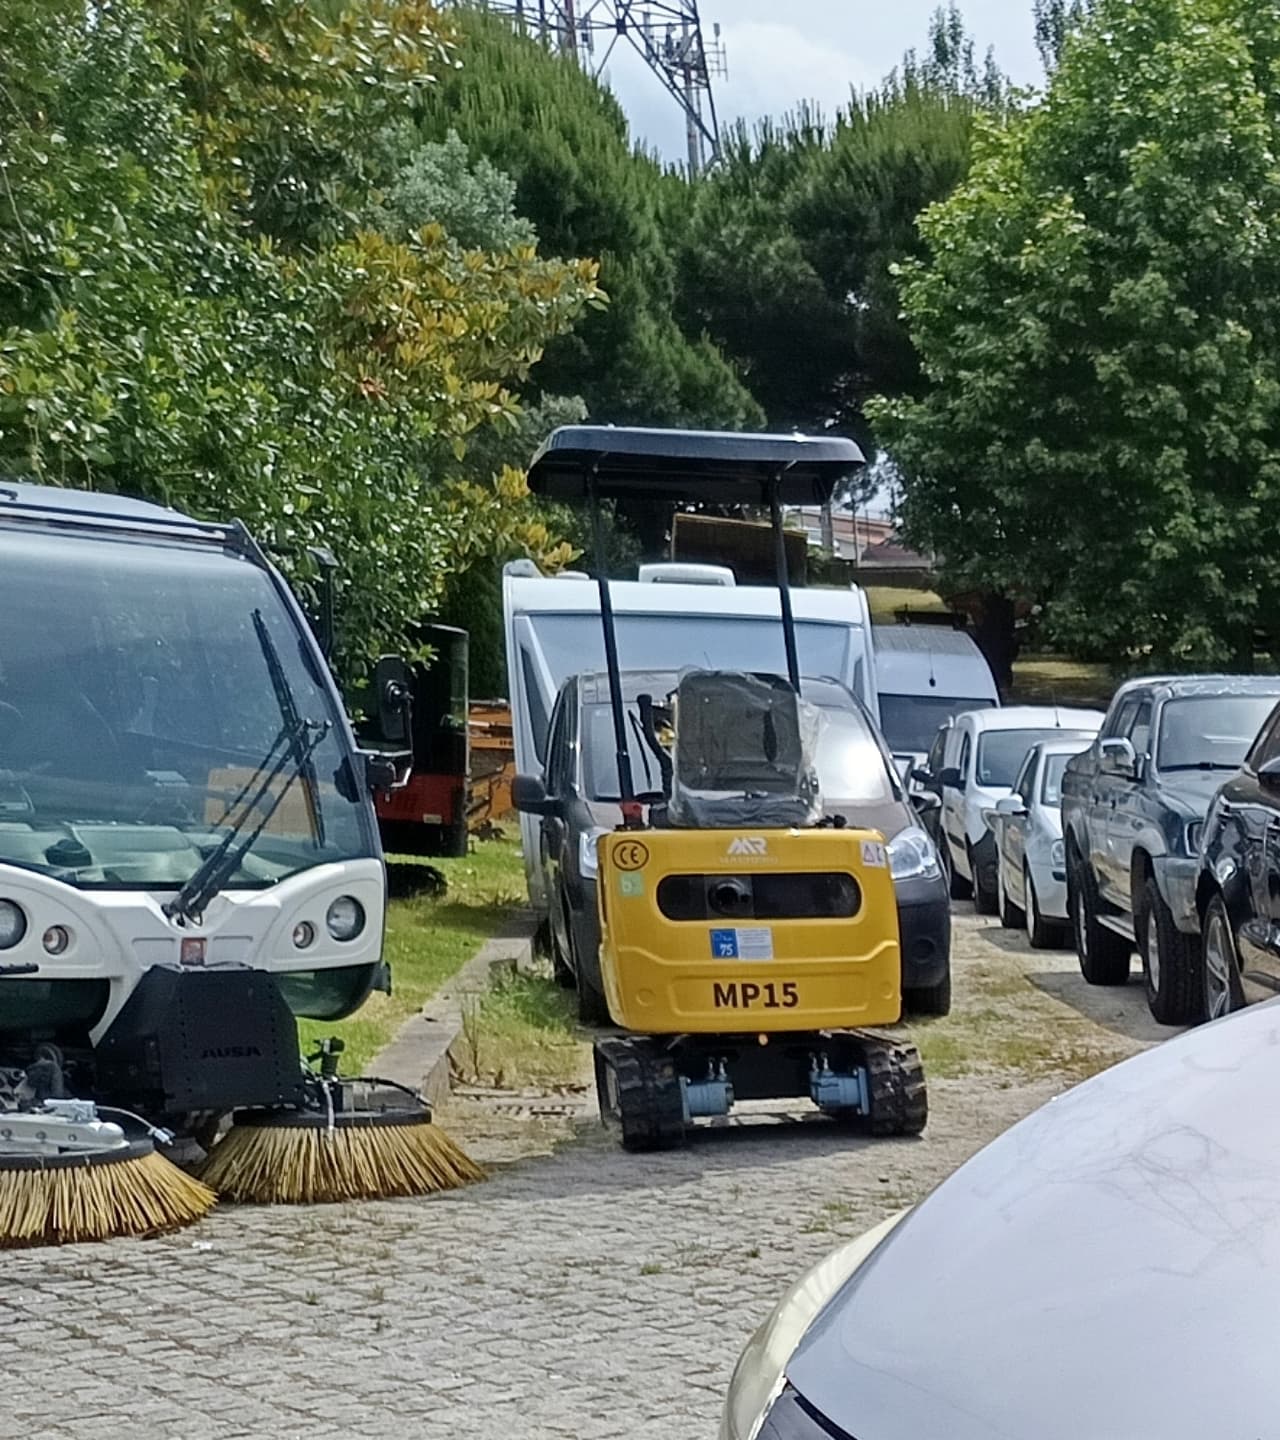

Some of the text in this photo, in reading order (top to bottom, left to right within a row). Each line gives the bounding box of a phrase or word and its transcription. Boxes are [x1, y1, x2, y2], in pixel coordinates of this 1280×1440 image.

[620, 846, 640, 865] CE
[713, 983, 799, 1008] MP15
[202, 1046, 261, 1058] AUSA
